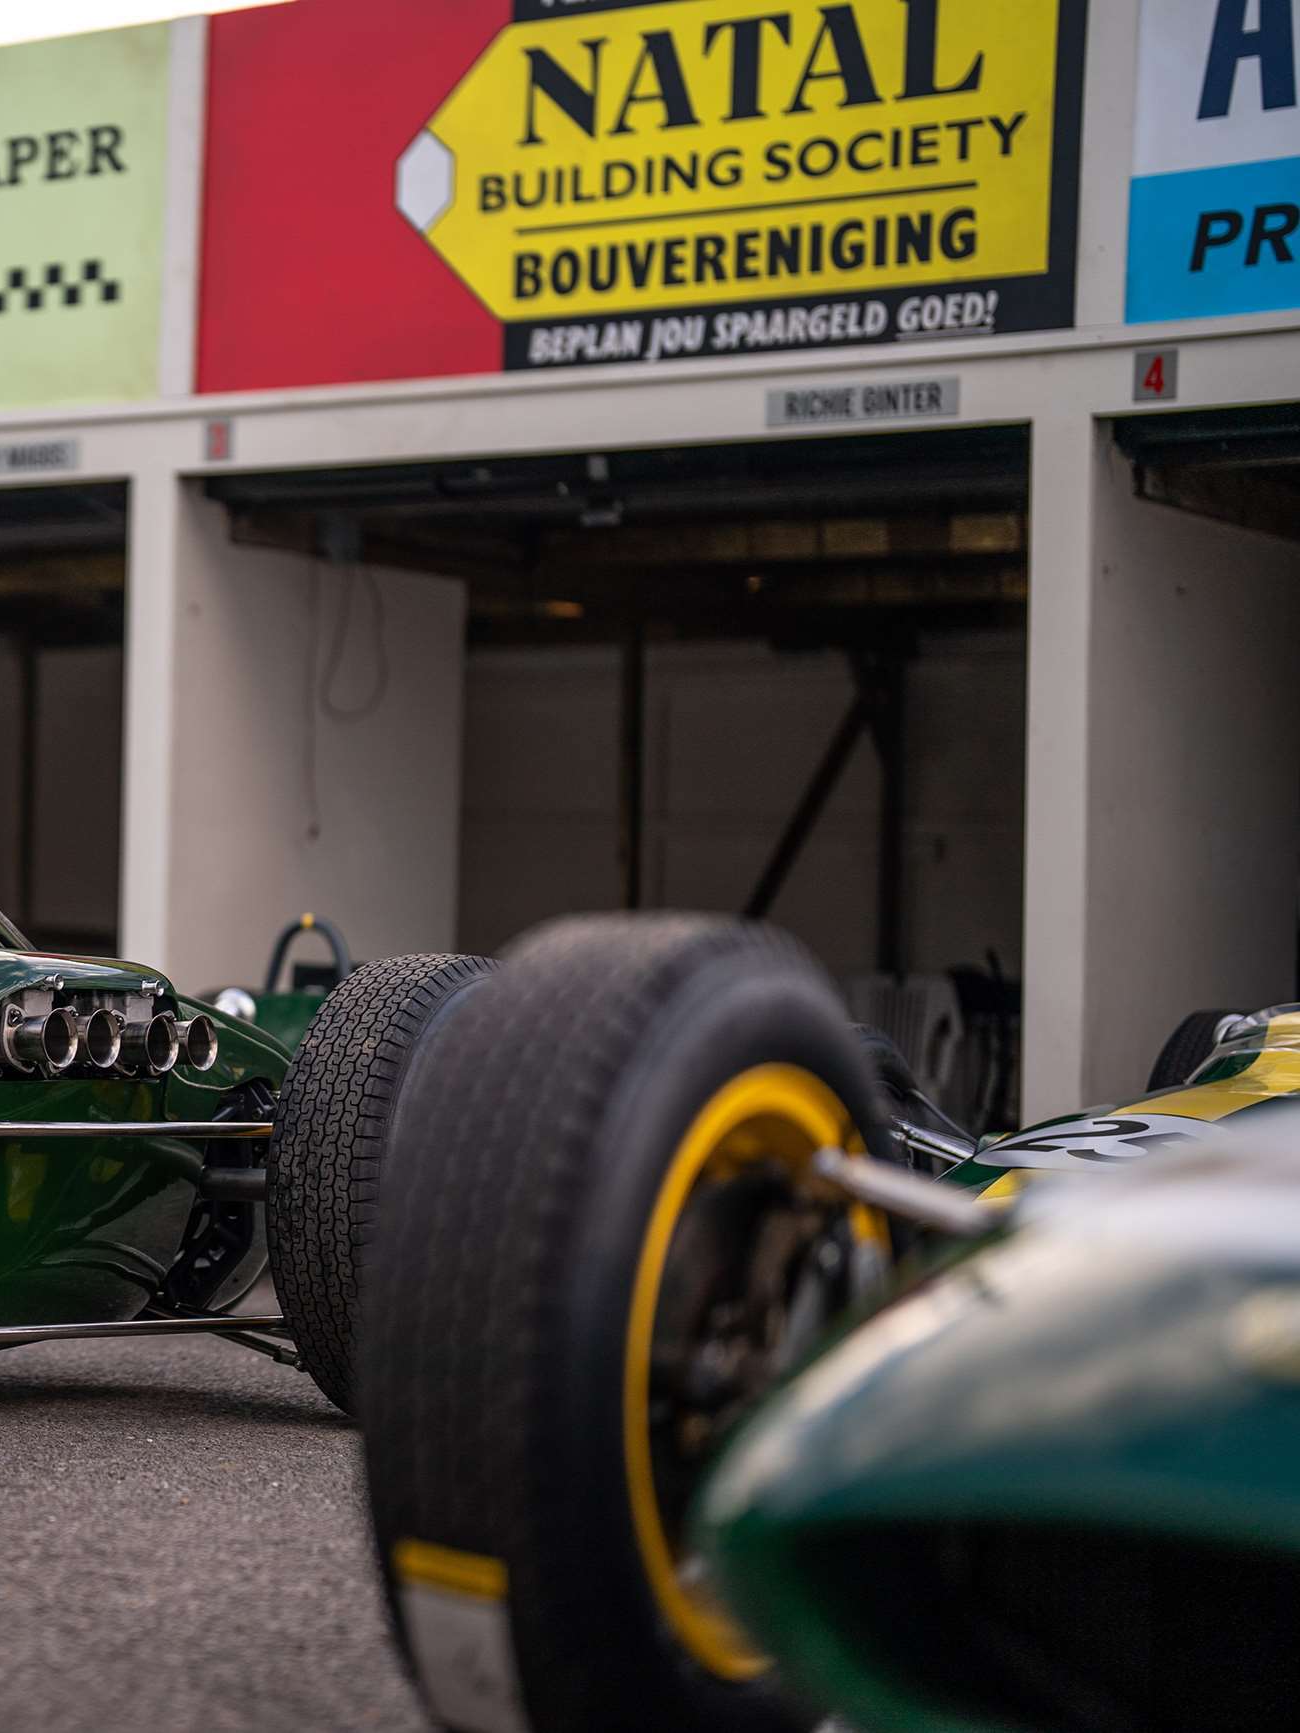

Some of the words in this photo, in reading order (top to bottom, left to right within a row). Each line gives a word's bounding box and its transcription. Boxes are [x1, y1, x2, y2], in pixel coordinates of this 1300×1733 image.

[518, 0, 986, 147] NATAL
[478, 148, 743, 214] BUILDING
[763, 112, 1028, 182] SOCIETY
[513, 208, 978, 300] BOUVERENIGING
[528, 319, 642, 364] BEPLAN
[644, 317, 706, 360] JOU
[711, 303, 888, 351] SPAARGELD
[897, 291, 999, 333] GOED!
[784, 387, 856, 418] RICHIE
[863, 381, 942, 416] GINTER
[1143, 355, 1164, 395] 4
